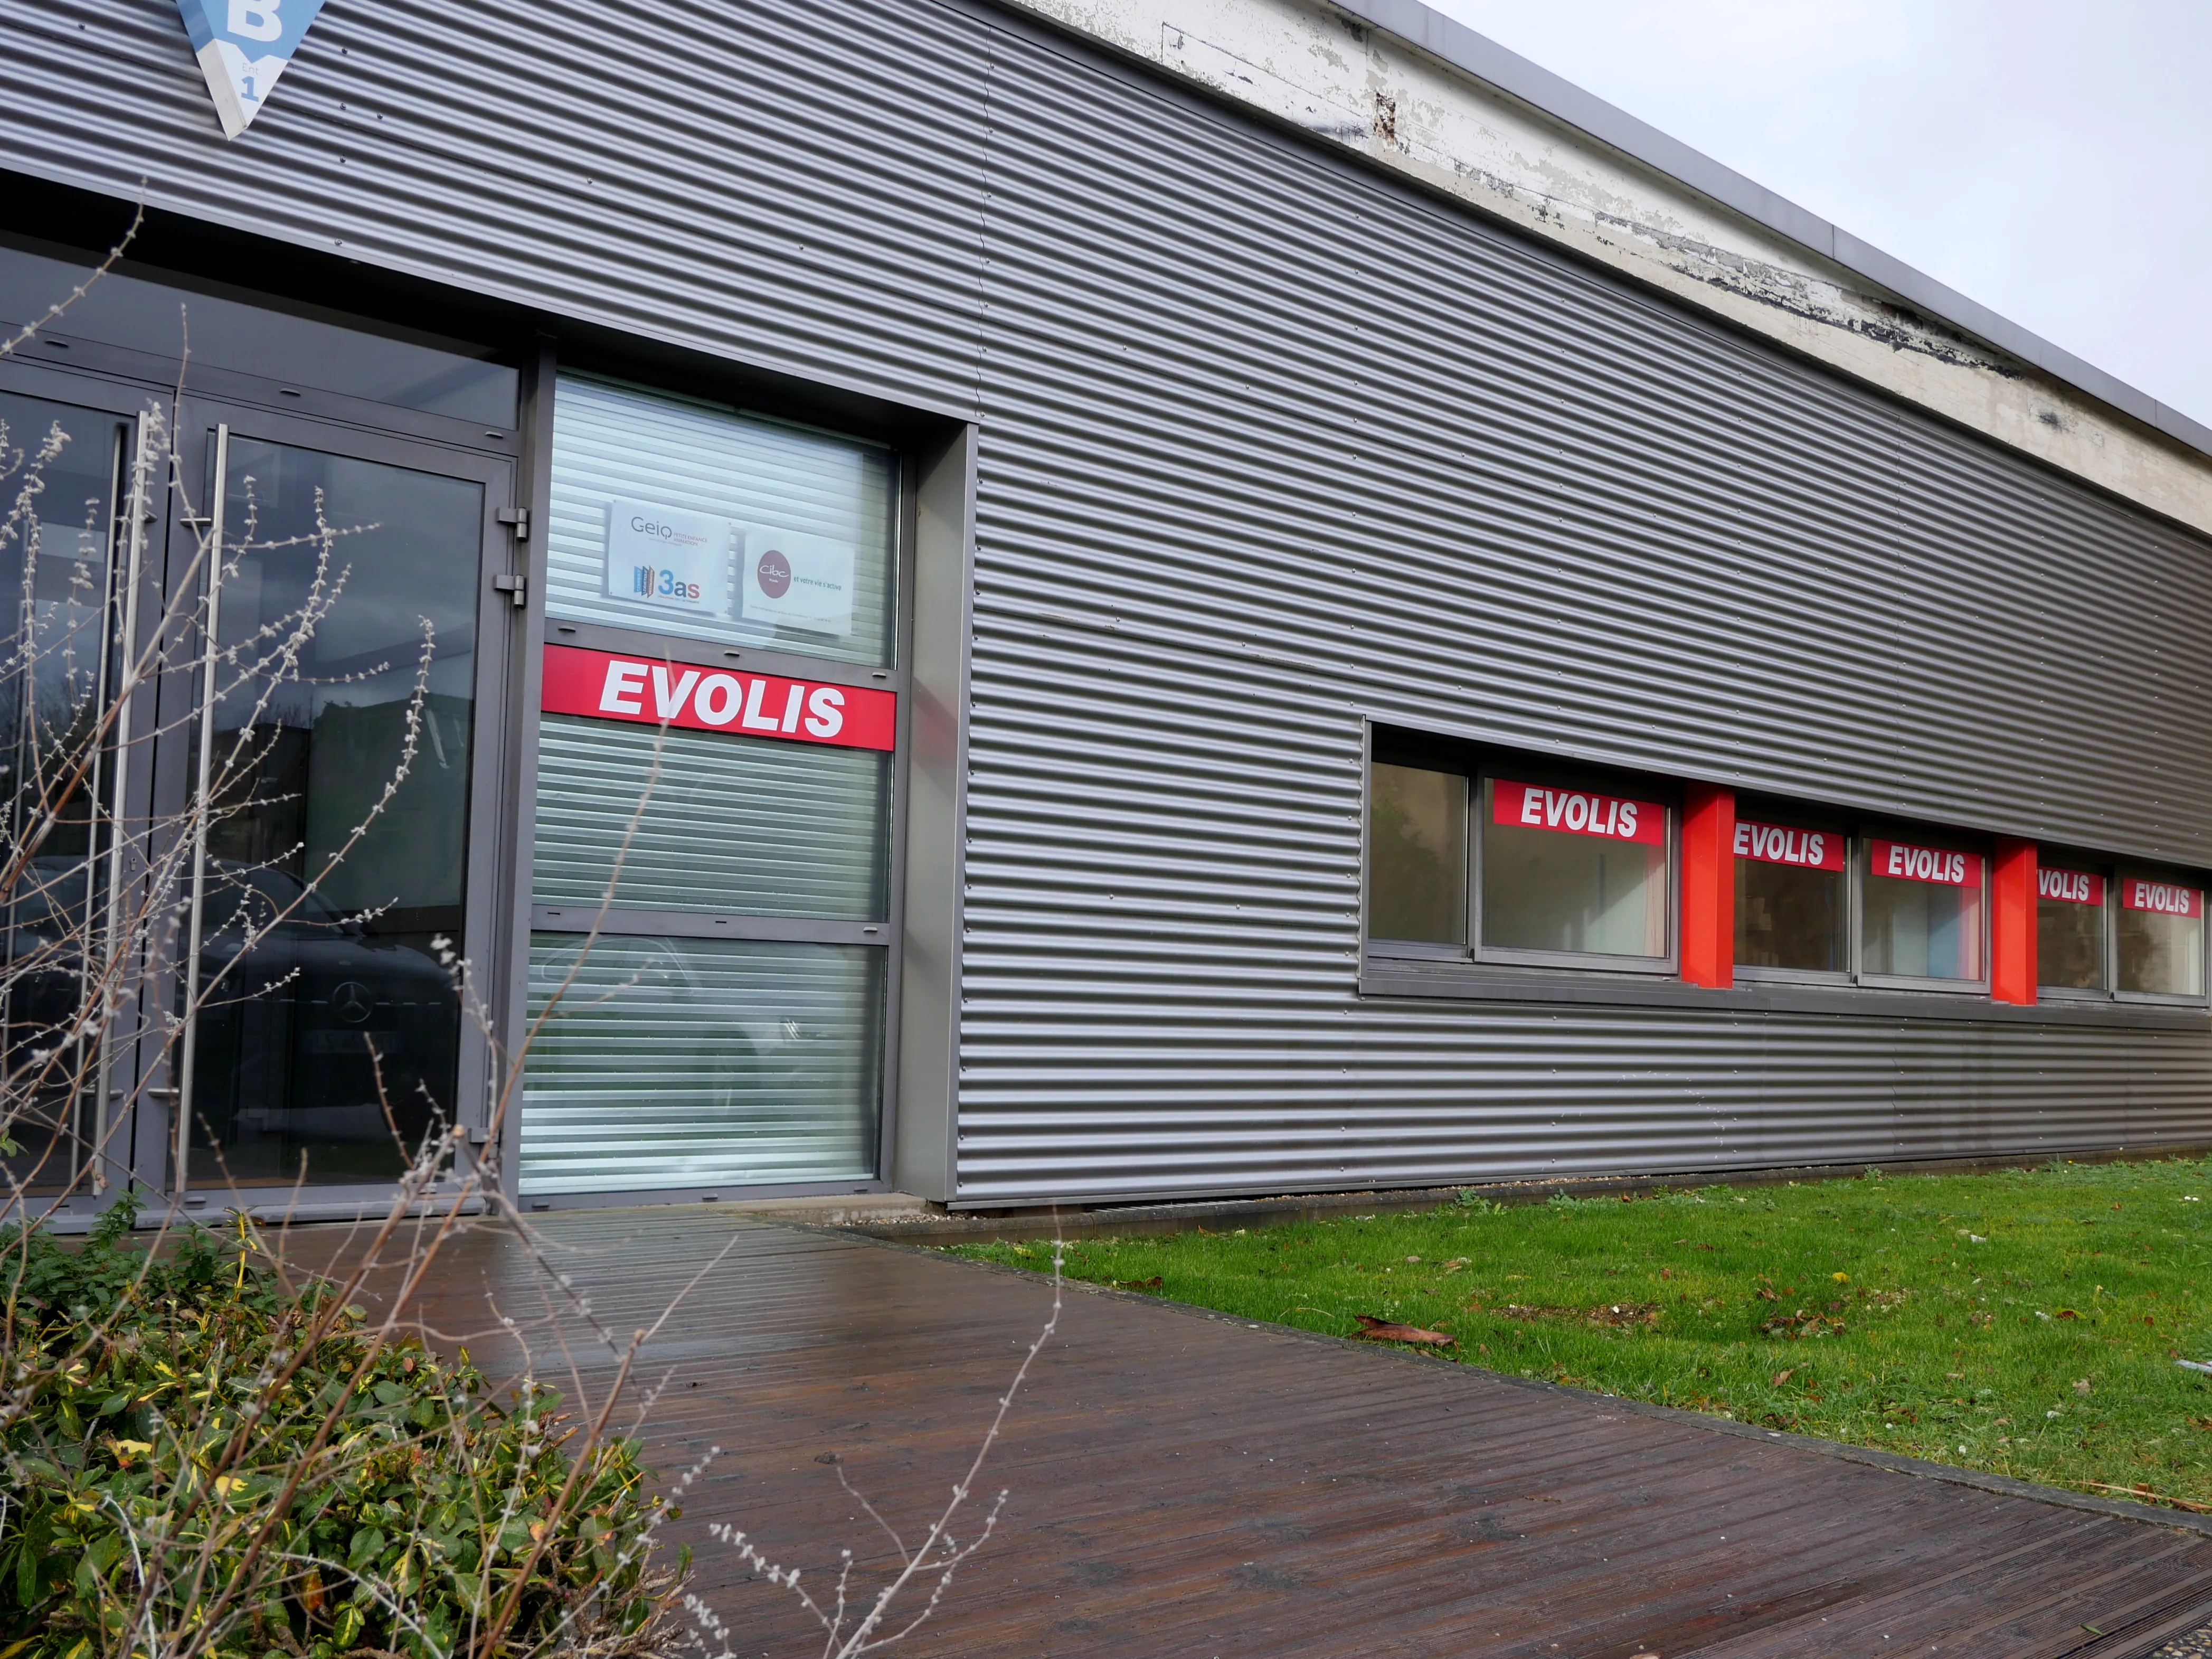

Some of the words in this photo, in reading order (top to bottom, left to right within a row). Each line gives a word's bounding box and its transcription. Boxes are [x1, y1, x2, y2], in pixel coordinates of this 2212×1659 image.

[227, 0, 282, 42] B
[241, 76, 259, 102] 1
[658, 569, 700, 599] 3as
[823, 581, 842, 591] s'active
[599, 660, 845, 738] EVOLIS
[1521, 788, 1637, 837] EVOLIS
[1733, 823, 1824, 865] EVOLIS
[1888, 845, 1964, 883] EVOLIS
[2036, 869, 2089, 901] VOLIS
[2134, 883, 2189, 914] EVOLIS
